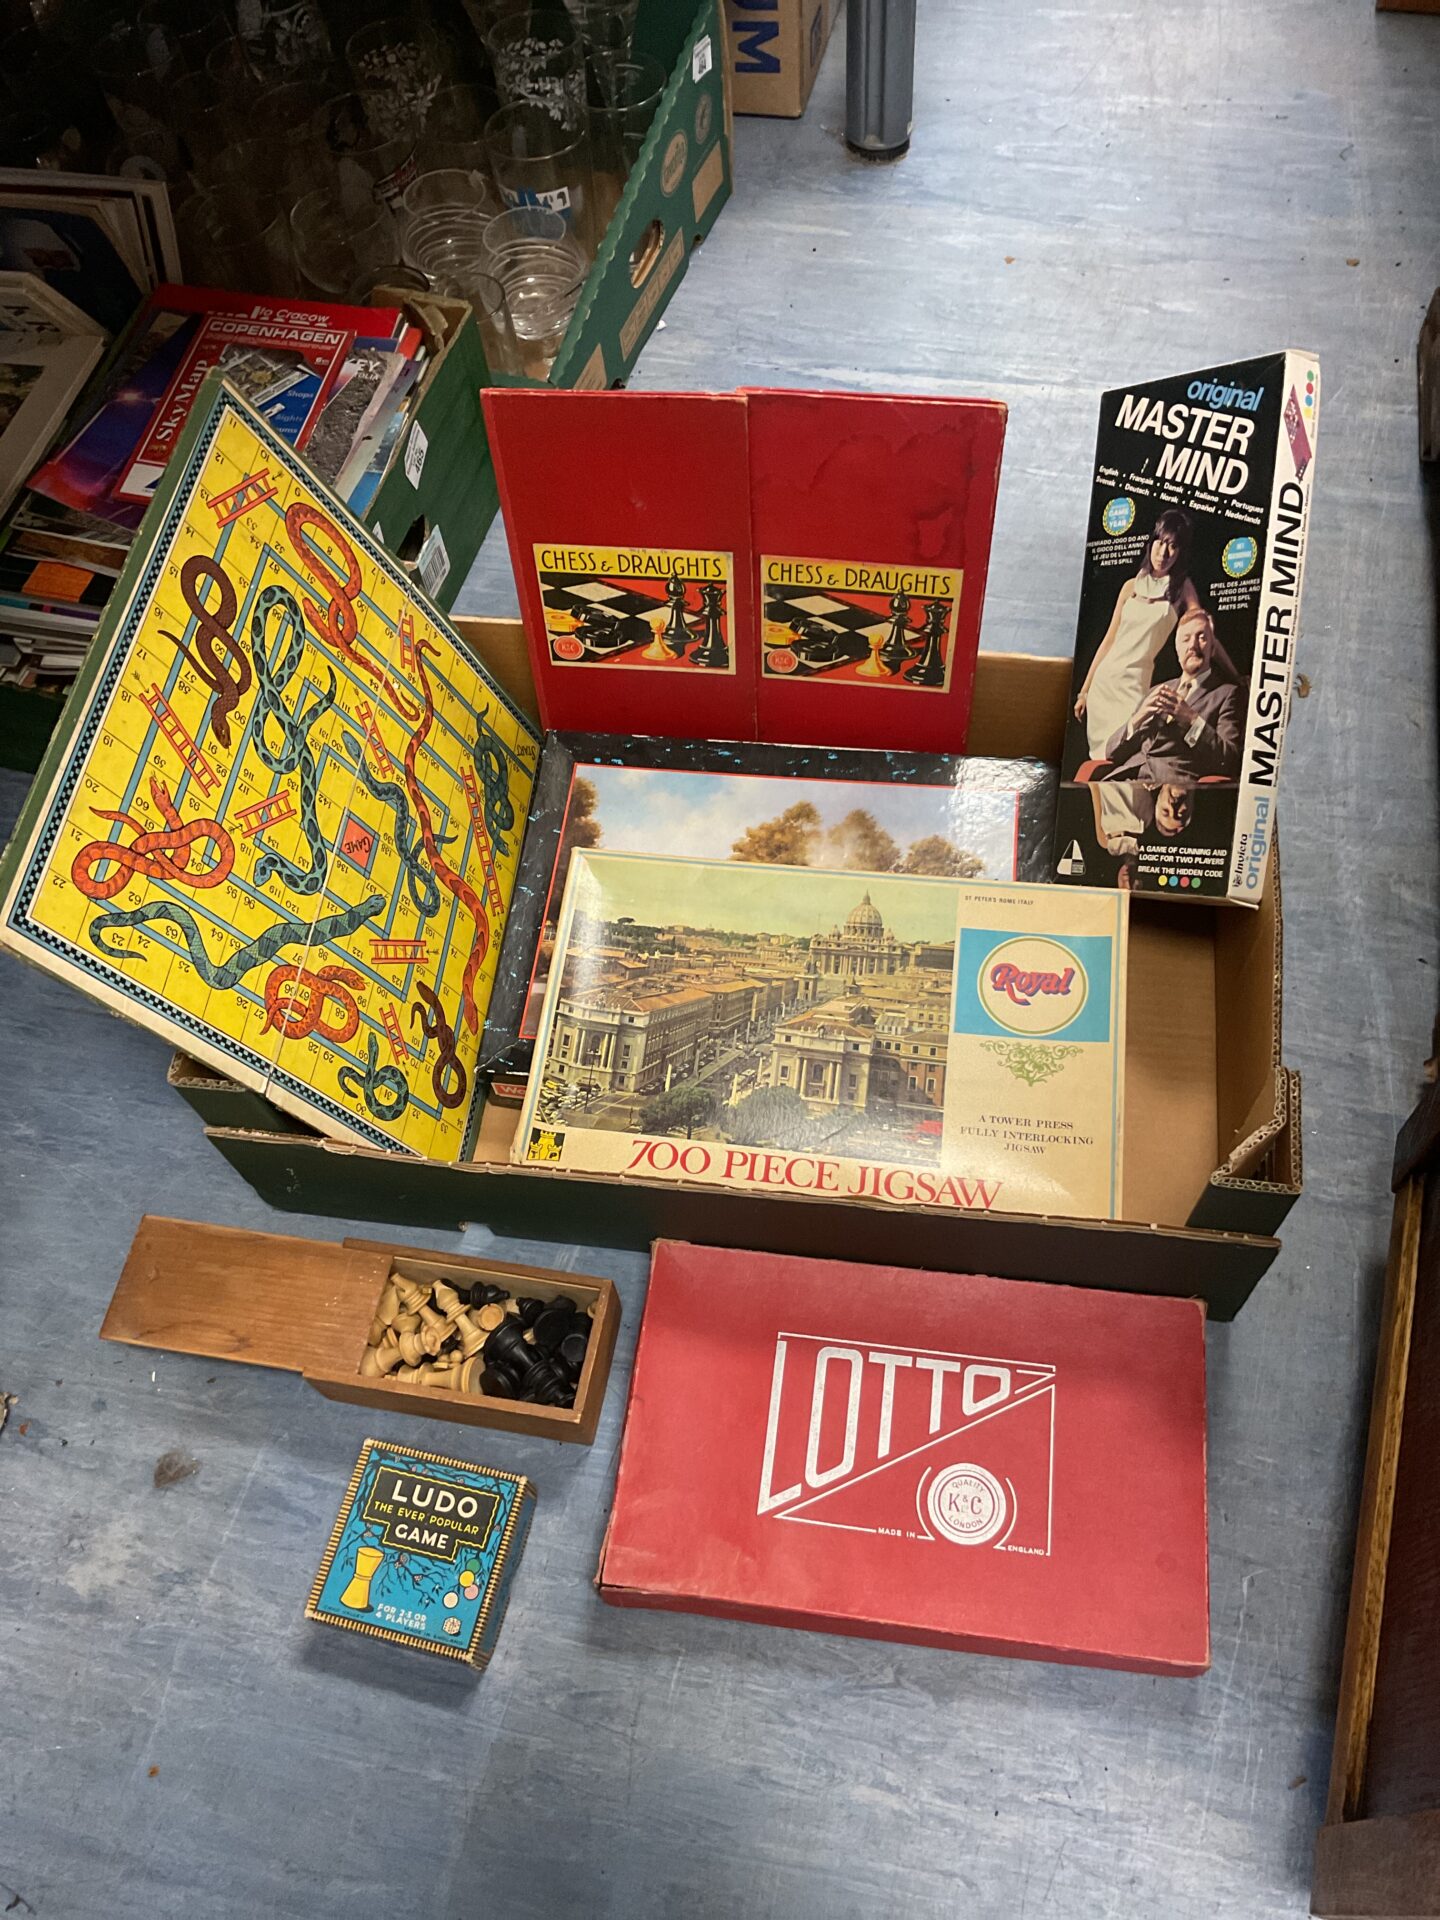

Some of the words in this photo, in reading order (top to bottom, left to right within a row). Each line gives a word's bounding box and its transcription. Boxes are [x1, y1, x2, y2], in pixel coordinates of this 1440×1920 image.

[276, 309, 330, 323] Cracow
[209, 321, 341, 344] COPENHAGEN
[1187, 378, 1264, 412] original
[228, 417, 237, 429] 11
[1115, 394, 1255, 455] MASTER
[260, 450, 270, 462] 10
[1156, 443, 1249, 495] MIND
[1099, 465, 1119, 477] English
[1164, 482, 1184, 494] Dansk
[1195, 490, 1219, 502] Italiano
[200, 488, 210, 501] 13
[1124, 483, 1150, 496] Deutsch
[1160, 492, 1179, 504] Norsk
[1224, 509, 1262, 525] Nederlands
[246, 517, 258, 531] 53
[1269, 482, 1304, 597] MIND
[269, 561, 281, 575] 87
[541, 550, 597, 571] CHESS
[600, 560, 613, 571] &
[618, 555, 722, 577] DRAUGHTS
[768, 562, 823, 583] CHESS
[826, 573, 840, 585] &
[844, 568, 951, 595] DRAUGHTS
[154, 607, 164, 619] 16
[136, 648, 148, 661] 17
[183, 670, 198, 684] 57
[178, 680, 191, 694] 58
[121, 690, 132, 704] 18
[1248, 605, 1292, 788] MASTER
[233, 710, 248, 725] 90
[103, 735, 114, 748] 19
[207, 741, 218, 754] 91
[153, 755, 166, 769] 59
[215, 764, 228, 777] 92
[243, 768, 255, 782] 116
[85, 778, 100, 793] 20
[238, 783, 250, 796] 117
[136, 796, 150, 811] 60
[189, 797, 201, 811] 93
[144, 818, 155, 831] 61
[70, 828, 83, 842] 21
[267, 835, 280, 849] 134
[344, 836, 371, 854] GAME
[1245, 796, 1270, 890] original
[1146, 845, 1167, 853] GAME
[1179, 848, 1211, 856] CUNNING
[1212, 849, 1227, 857] AND
[1139, 854, 1159, 862] LOGIC
[1160, 855, 1174, 863] FOR
[1175, 856, 1193, 864] TWO
[1194, 857, 1225, 866] PLAYERS
[1138, 865, 1160, 874] BREAK
[1161, 867, 1175, 875] THE
[1176, 868, 1203, 877] HIDDEN
[1204, 869, 1224, 878] CODE
[52, 875, 66, 889] 22
[226, 885, 238, 899] 95
[269, 884, 281, 898] 119
[128, 891, 142, 906] 62
[243, 895, 257, 910] 96
[285, 900, 300, 914] 120
[326, 900, 338, 914] 121
[165, 925, 179, 939] 63
[210, 927, 224, 941] 64
[136, 934, 151, 950] 24
[318, 948, 329, 961] 98
[352, 946, 364, 960] 122
[178, 960, 191, 973] 25
[990, 962, 1076, 1006] Royal
[236, 996, 248, 1010] 26
[254, 1007, 265, 1020] 27
[335, 1007, 346, 1020] 68
[308, 1041, 319, 1054] 28
[323, 1050, 335, 1064] 29
[356, 1102, 367, 1116] 30
[411, 1108, 422, 1120] 32
[978, 1115, 987, 1123] A
[989, 1115, 1032, 1128] TOWER
[1036, 1120, 1074, 1130] PRESS
[960, 1126, 999, 1139] FULLY
[1003, 1130, 1094, 1146] INTERLOCKING
[1003, 1143, 1046, 1155] JIGSAW
[627, 1139, 712, 1175] 700
[721, 1150, 840, 1192] PIECE
[847, 1165, 1004, 1208] JIGSAW
[757, 1340, 1012, 1516] LOTTO
[951, 1479, 985, 1492] QUALITY
[391, 1479, 478, 1518] LUDO
[374, 1500, 394, 1514] THE
[397, 1507, 425, 1522] EVER
[429, 1515, 479, 1535] POPULAR
[949, 1515, 983, 1529] LONDON
[395, 1523, 449, 1550] GAME
[878, 1527, 902, 1538] MADE
[906, 1531, 916, 1539] IN
[1007, 1545, 1045, 1556] ENGLAND
[377, 1603, 397, 1614] FOR
[414, 1613, 427, 1622] OR
[385, 1612, 426, 1631] PLAYERS
